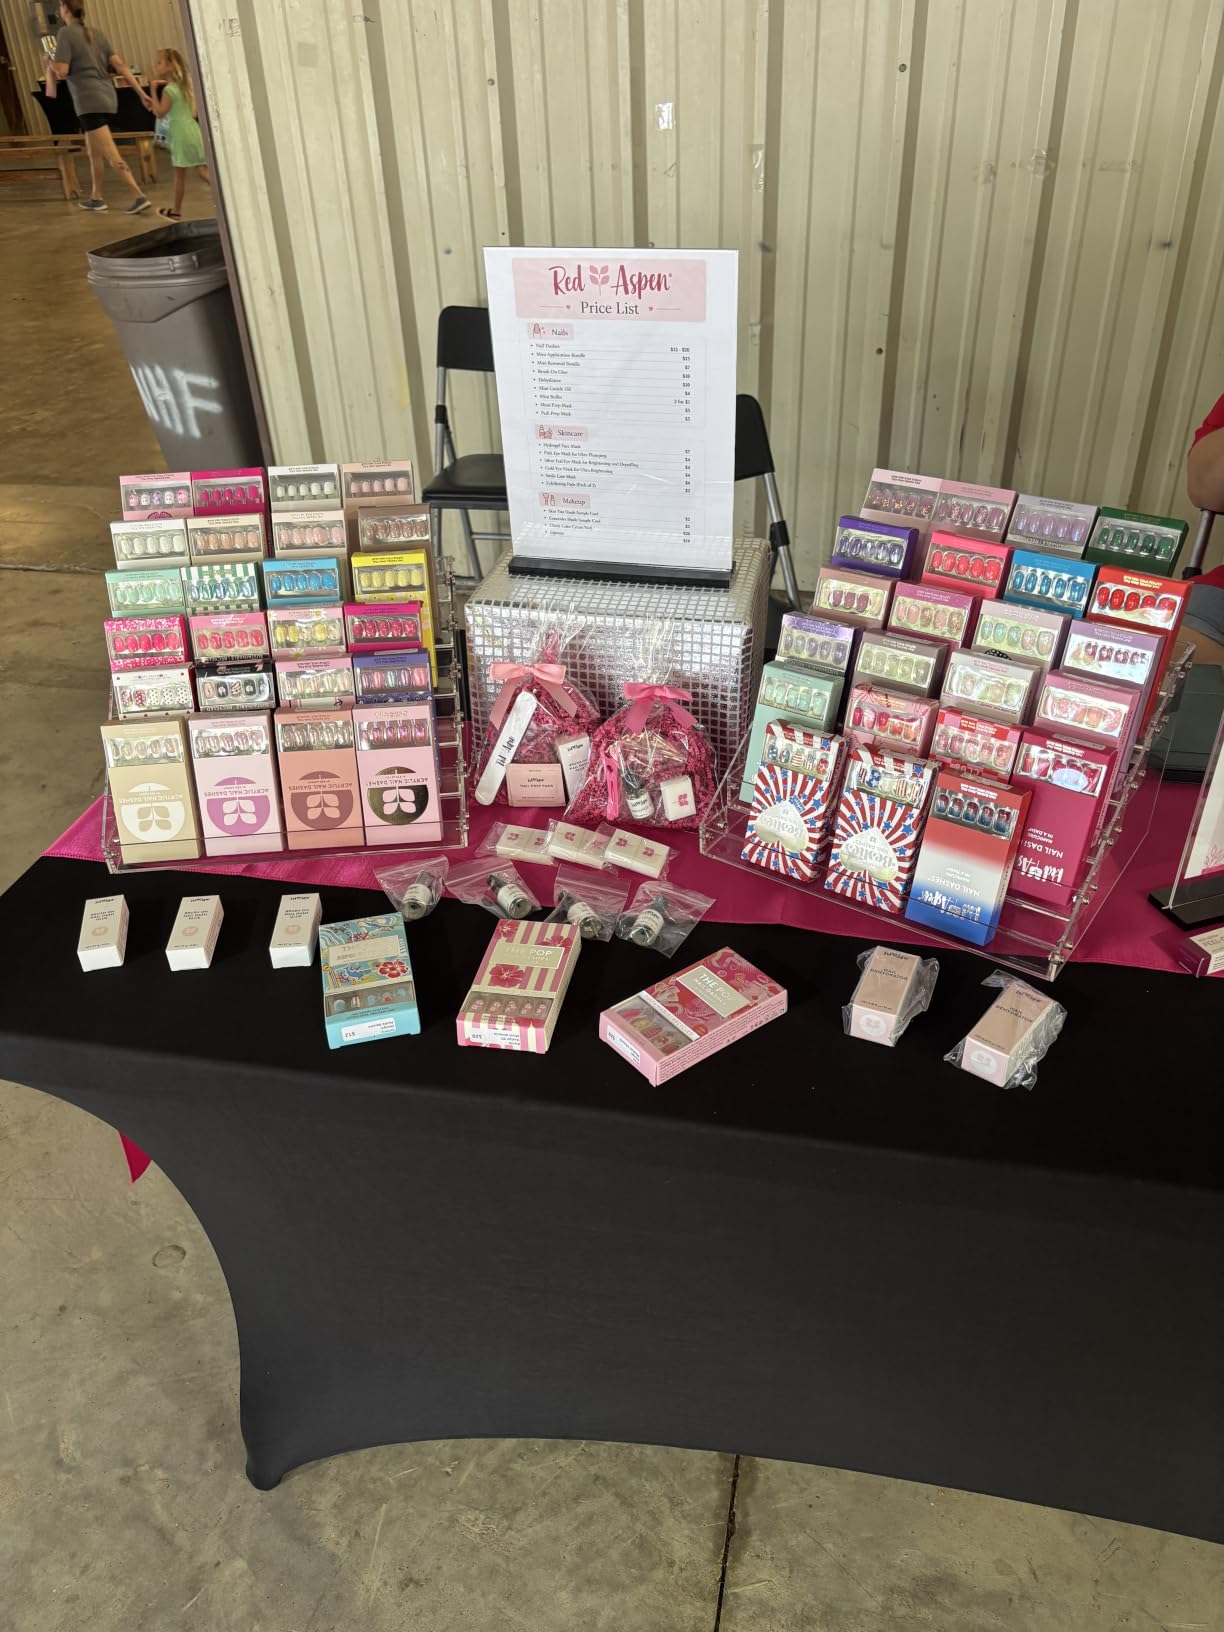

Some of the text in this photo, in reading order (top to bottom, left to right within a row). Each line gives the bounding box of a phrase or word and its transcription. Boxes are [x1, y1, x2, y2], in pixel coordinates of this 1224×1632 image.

[548, 264, 671, 300] Red Aspen
[580, 301, 640, 314] Price List
[557, 429, 584, 437] Skincare
[847, 844, 896, 868] Besties
[1044, 847, 1063, 858] NAIL
[963, 885, 980, 896] NAIL
[870, 969, 908, 980] DEHYDRATOR
[699, 974, 715, 989] THE
